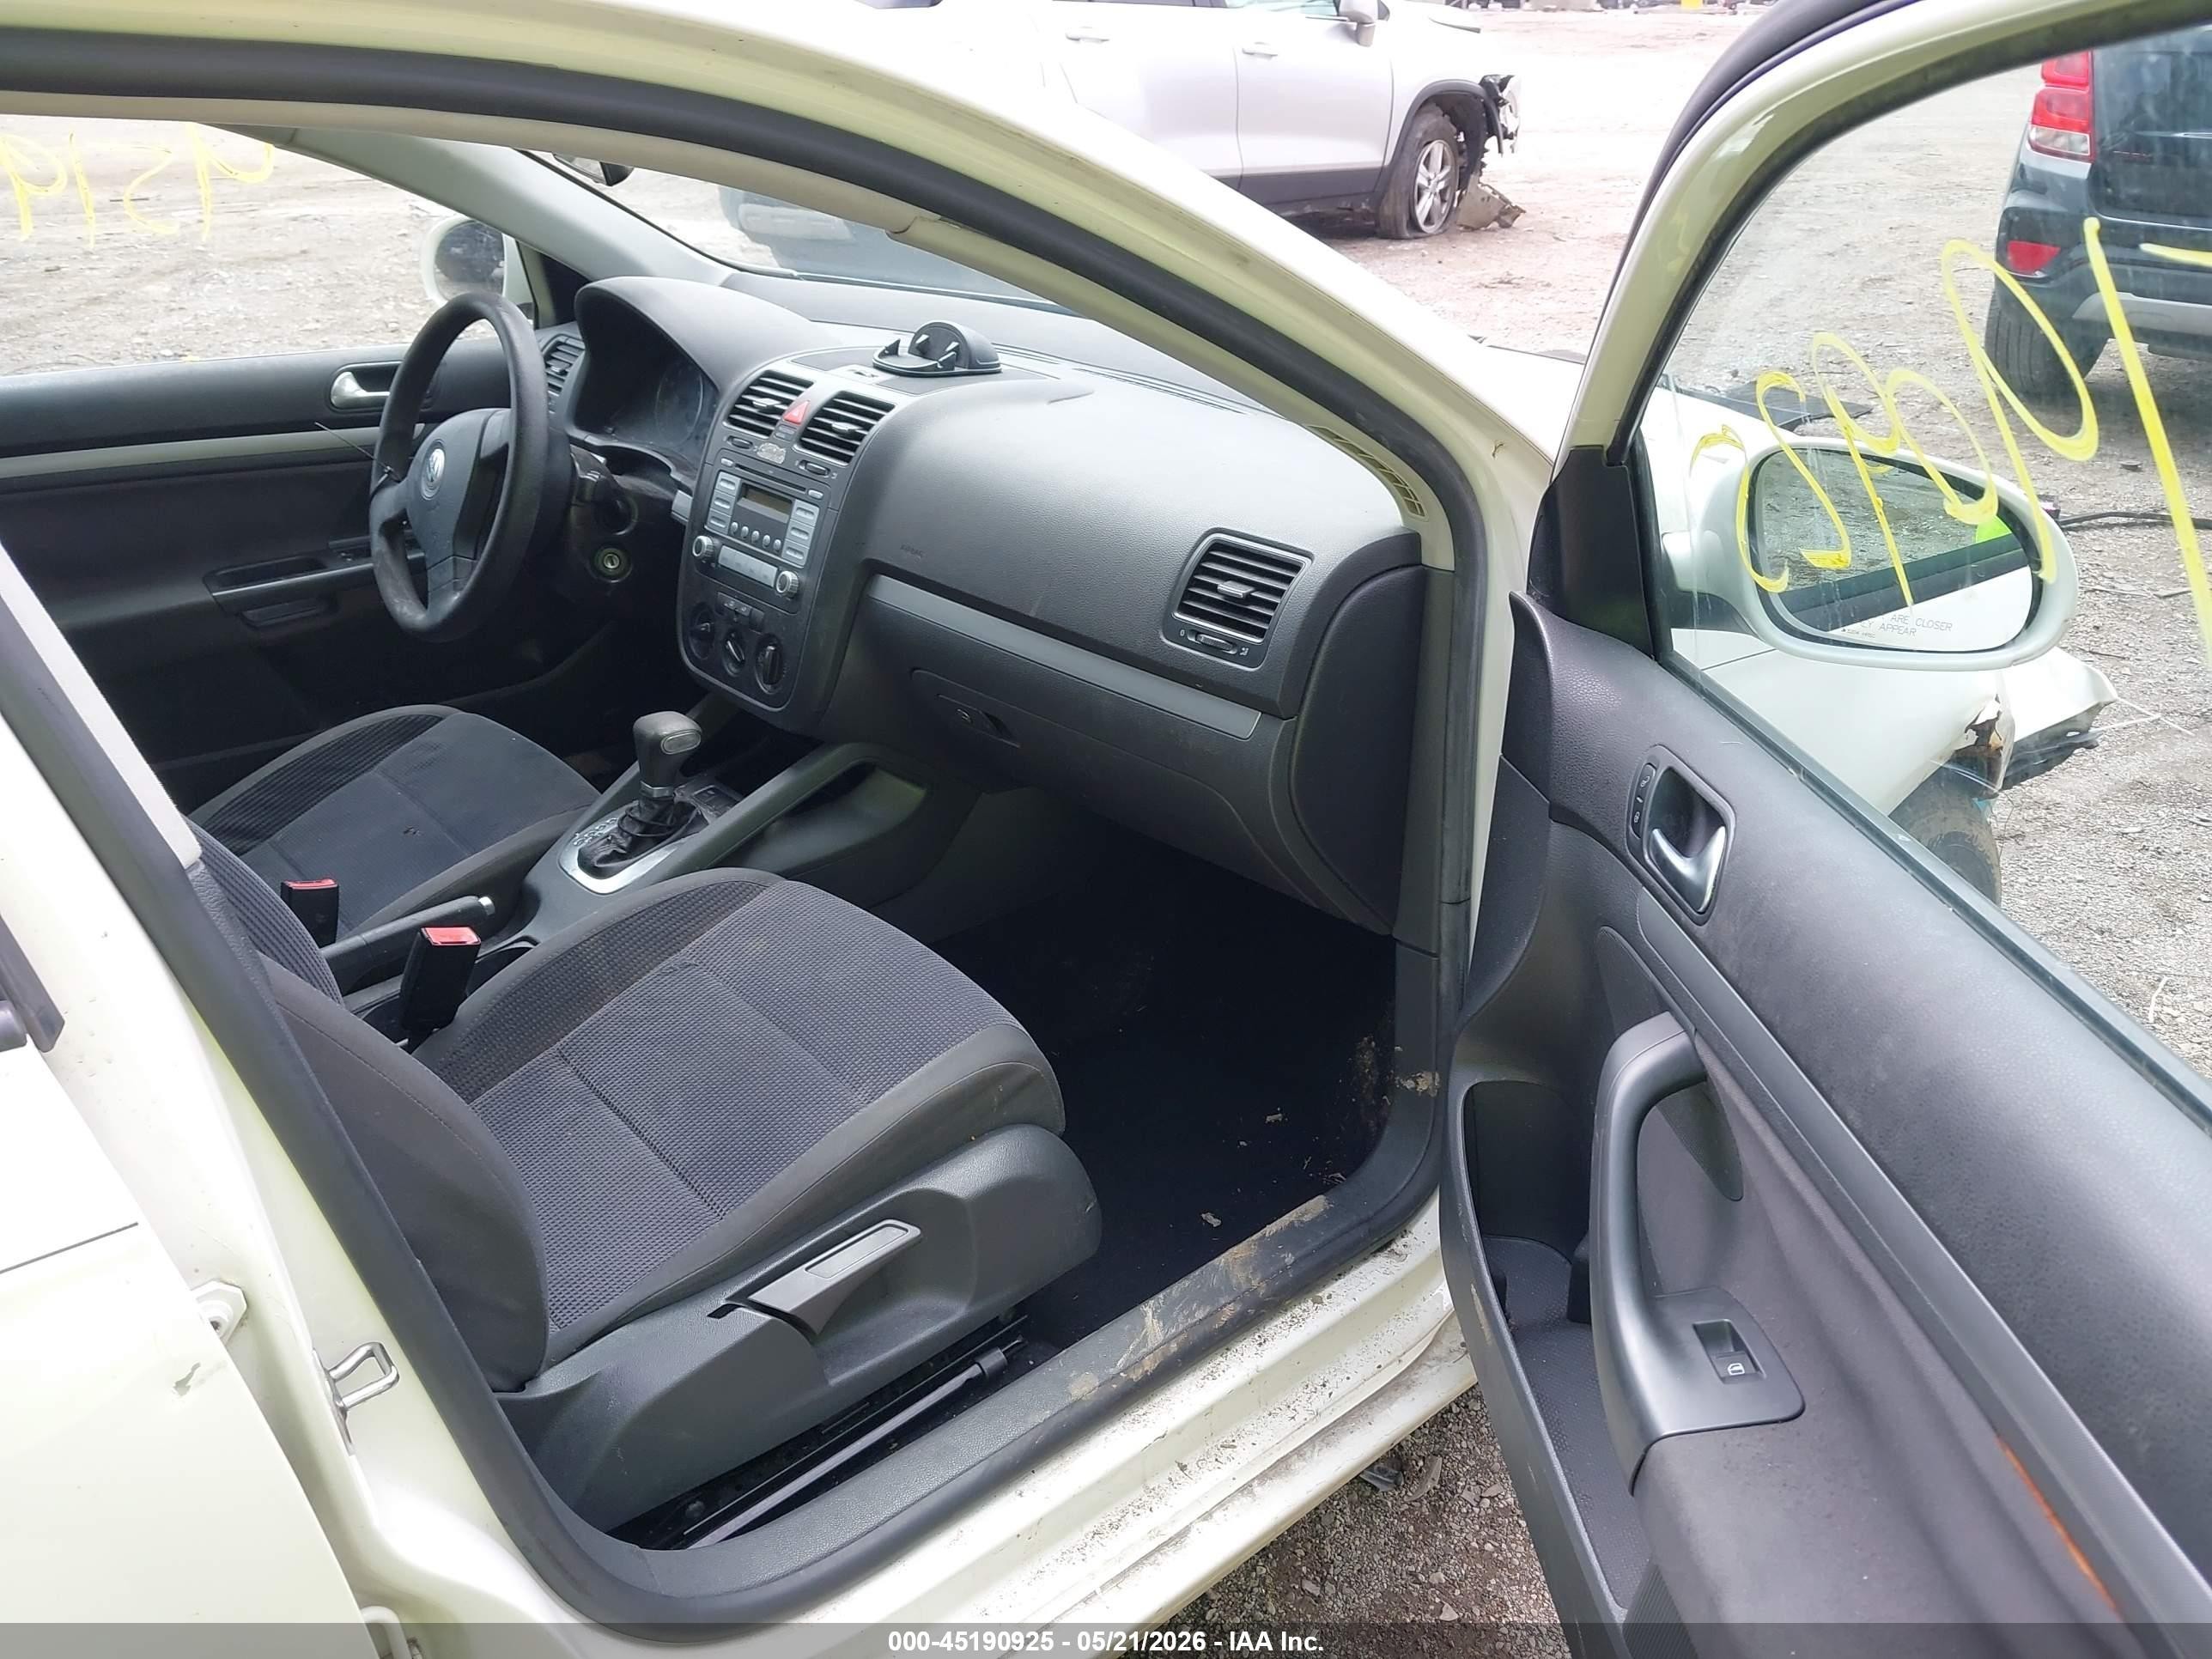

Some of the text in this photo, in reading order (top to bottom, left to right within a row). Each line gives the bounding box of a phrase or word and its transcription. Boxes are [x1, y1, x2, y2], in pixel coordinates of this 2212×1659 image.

[1879, 623, 1917, 636] APPEAR
[1890, 614, 1911, 625] ARE
[1915, 617, 1953, 631] CLOSER
